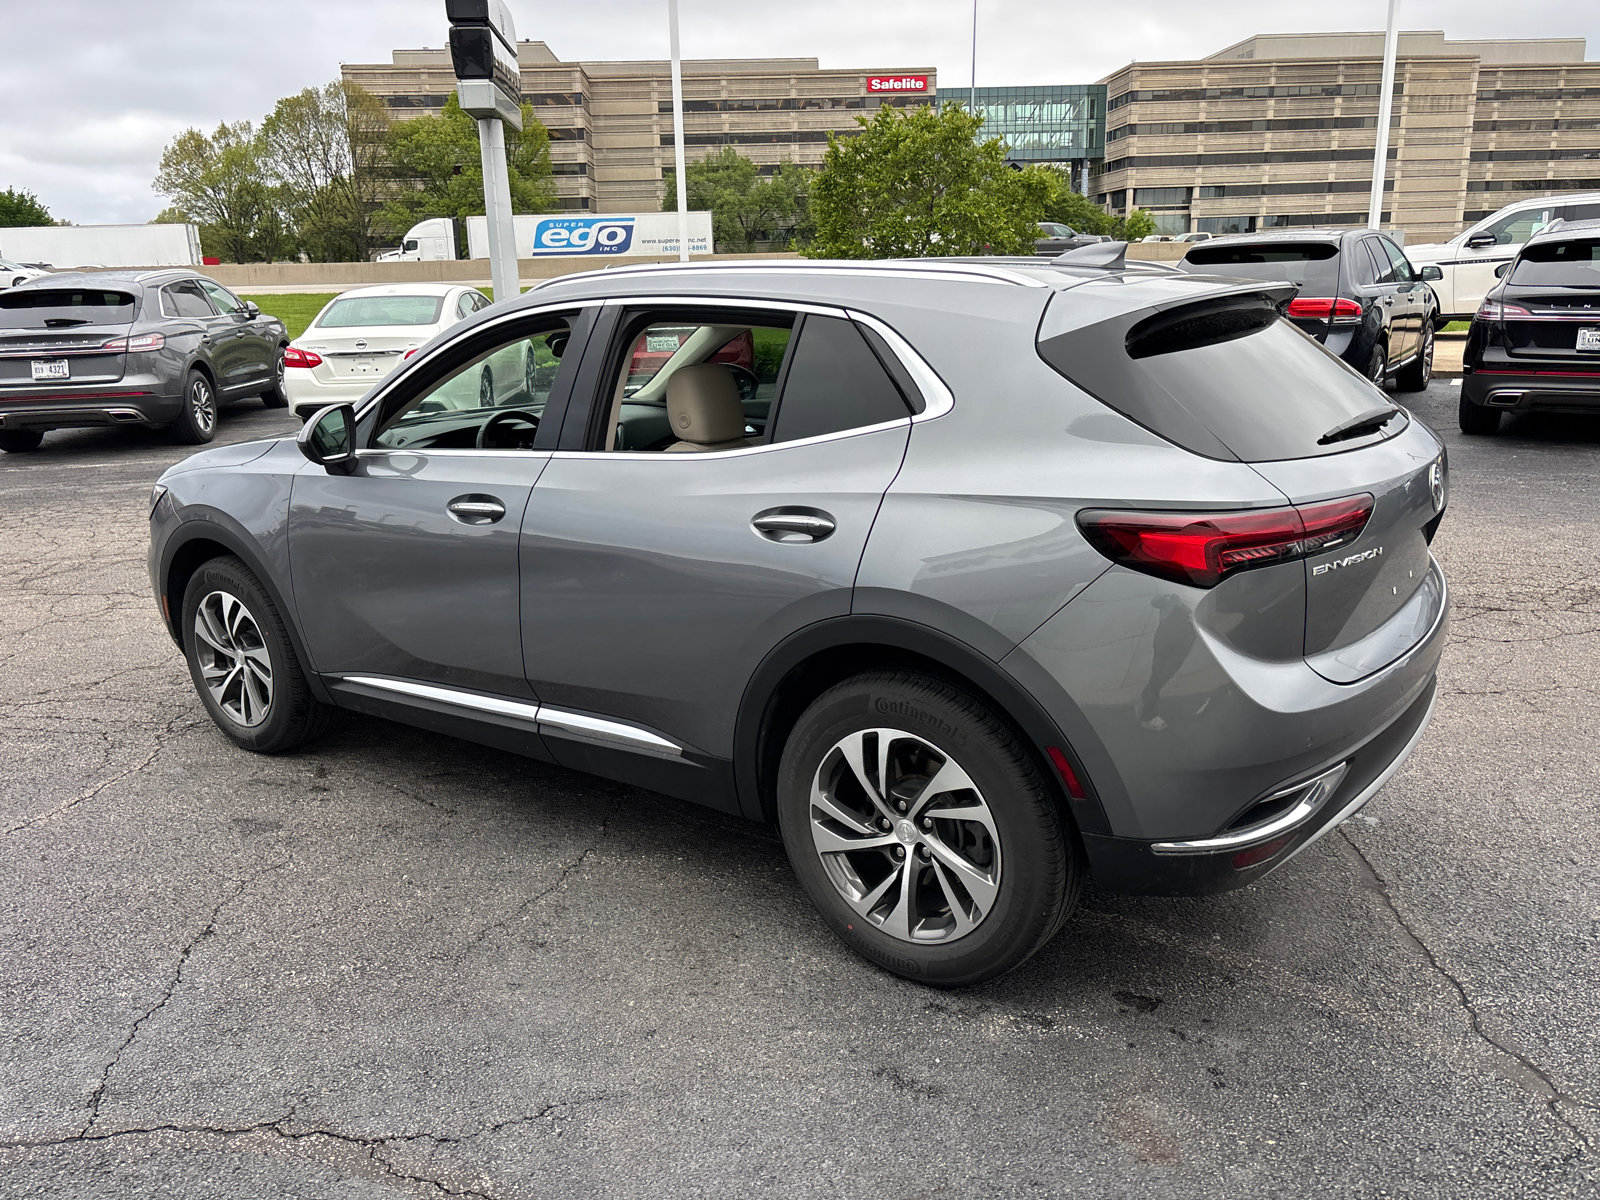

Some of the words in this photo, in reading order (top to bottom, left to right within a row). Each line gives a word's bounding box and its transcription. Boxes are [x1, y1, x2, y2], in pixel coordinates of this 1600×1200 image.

[871, 78, 924, 90] Safelite
[541, 226, 627, 250] ego
[48, 364, 65, 375] 4321
[1312, 546, 1383, 576] ENVISION
[874, 696, 959, 739] Continental
